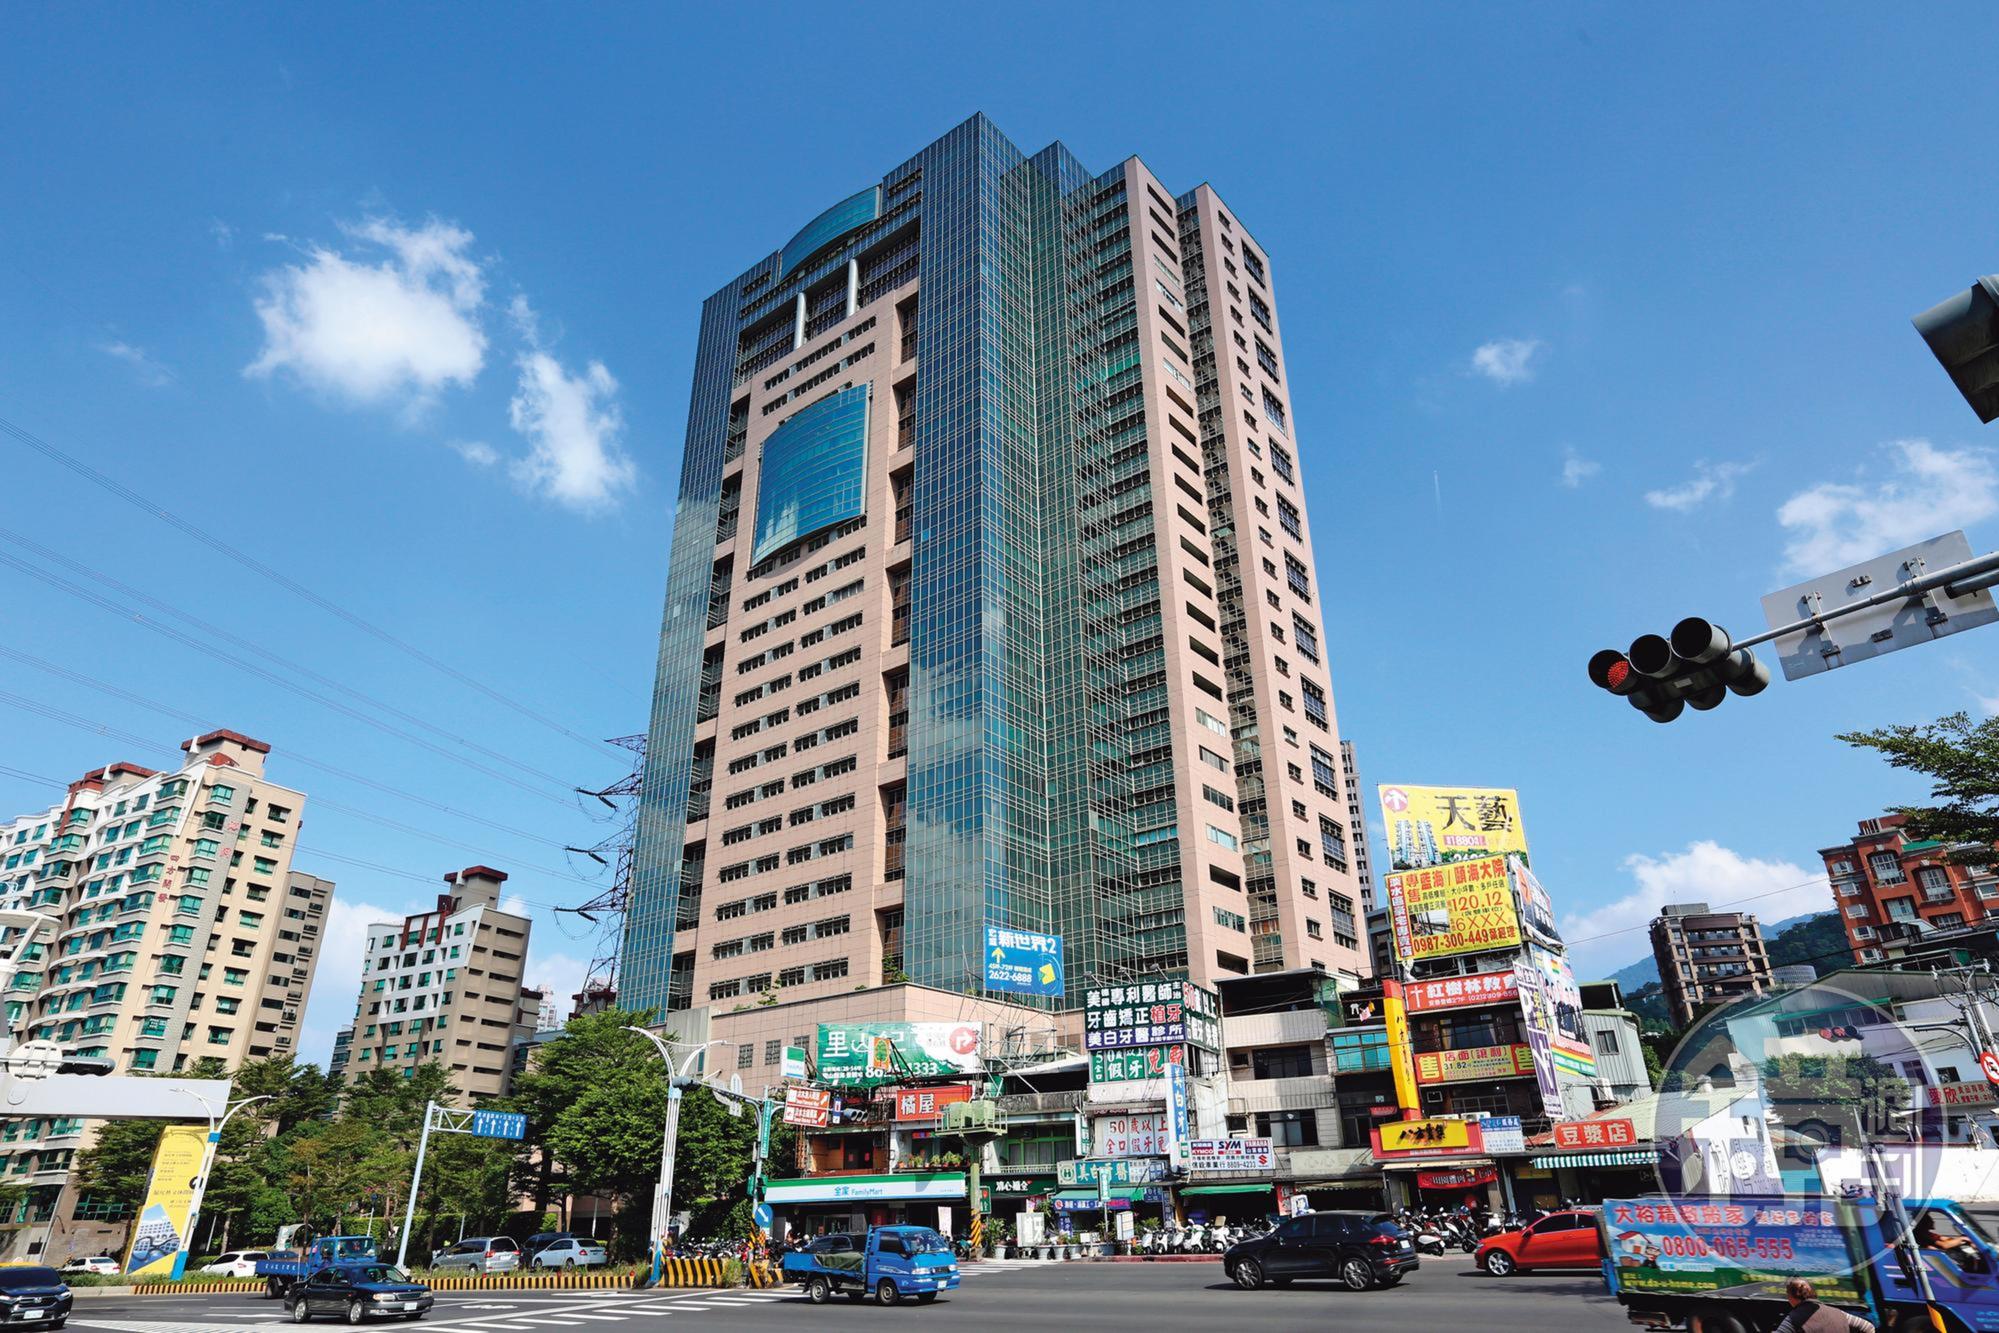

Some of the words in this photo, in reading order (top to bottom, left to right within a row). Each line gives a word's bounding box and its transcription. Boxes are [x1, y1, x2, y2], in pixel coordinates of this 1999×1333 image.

[1435, 795, 1513, 832] 天藝
[998, 930, 1057, 954] 新世界2
[1413, 930, 1489, 953] 0987-300-449
[988, 970, 1033, 983] 2622-6888
[1087, 1003, 1182, 1029] 牙齒矯正植牙
[1087, 1023, 1183, 1047] 美白牙醫診所
[901, 1093, 935, 1115] 橘屋
[1561, 1122, 1628, 1145] 豆漿店
[1219, 1141, 1241, 1150] SYM
[834, 1186, 849, 1196] 全家
[851, 1187, 883, 1196] FamilyMart
[1662, 1235, 1793, 1260] 0800-065-555
